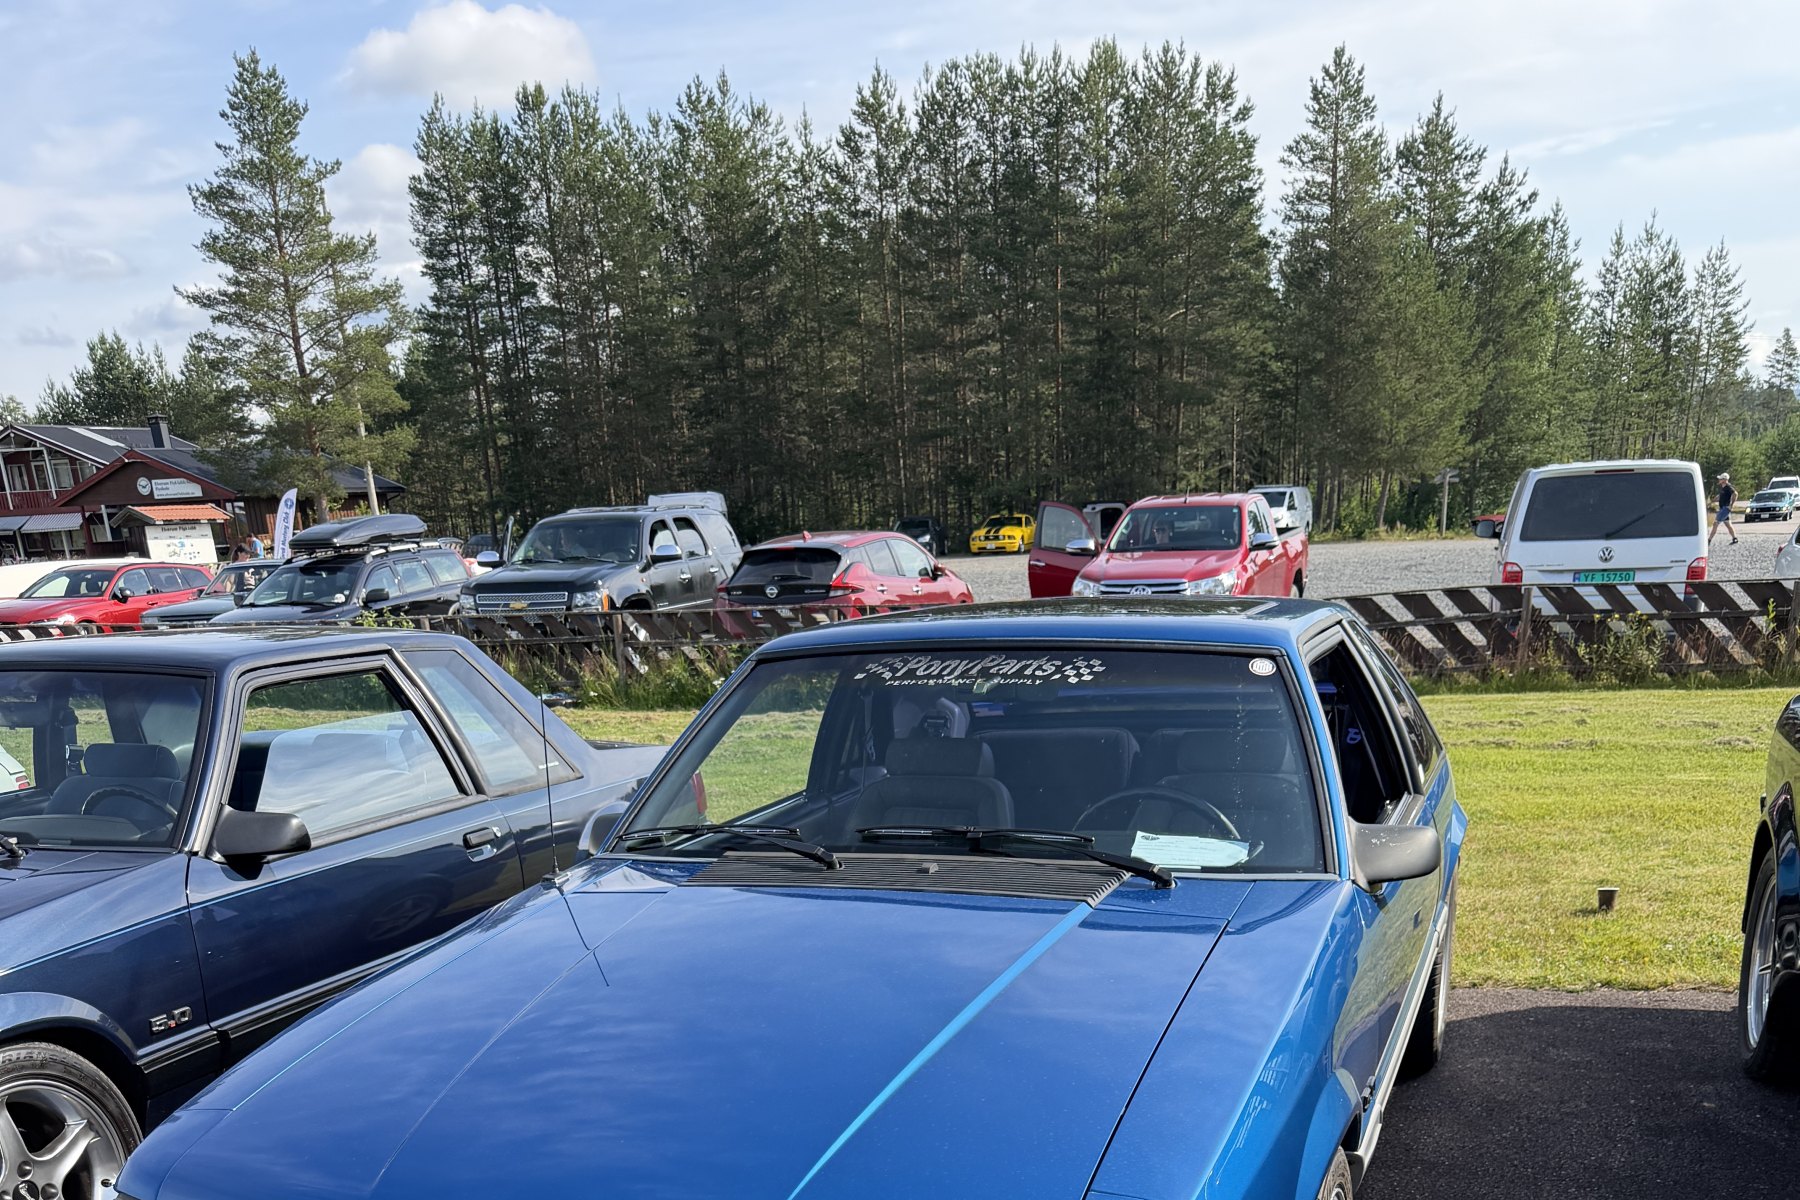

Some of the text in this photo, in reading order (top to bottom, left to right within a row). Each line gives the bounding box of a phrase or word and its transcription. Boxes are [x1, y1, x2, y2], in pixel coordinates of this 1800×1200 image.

[1583, 572, 1631, 582] YF 15750
[894, 654, 1062, 680] PonyParts
[150, 1006, 193, 1034] 5.0
